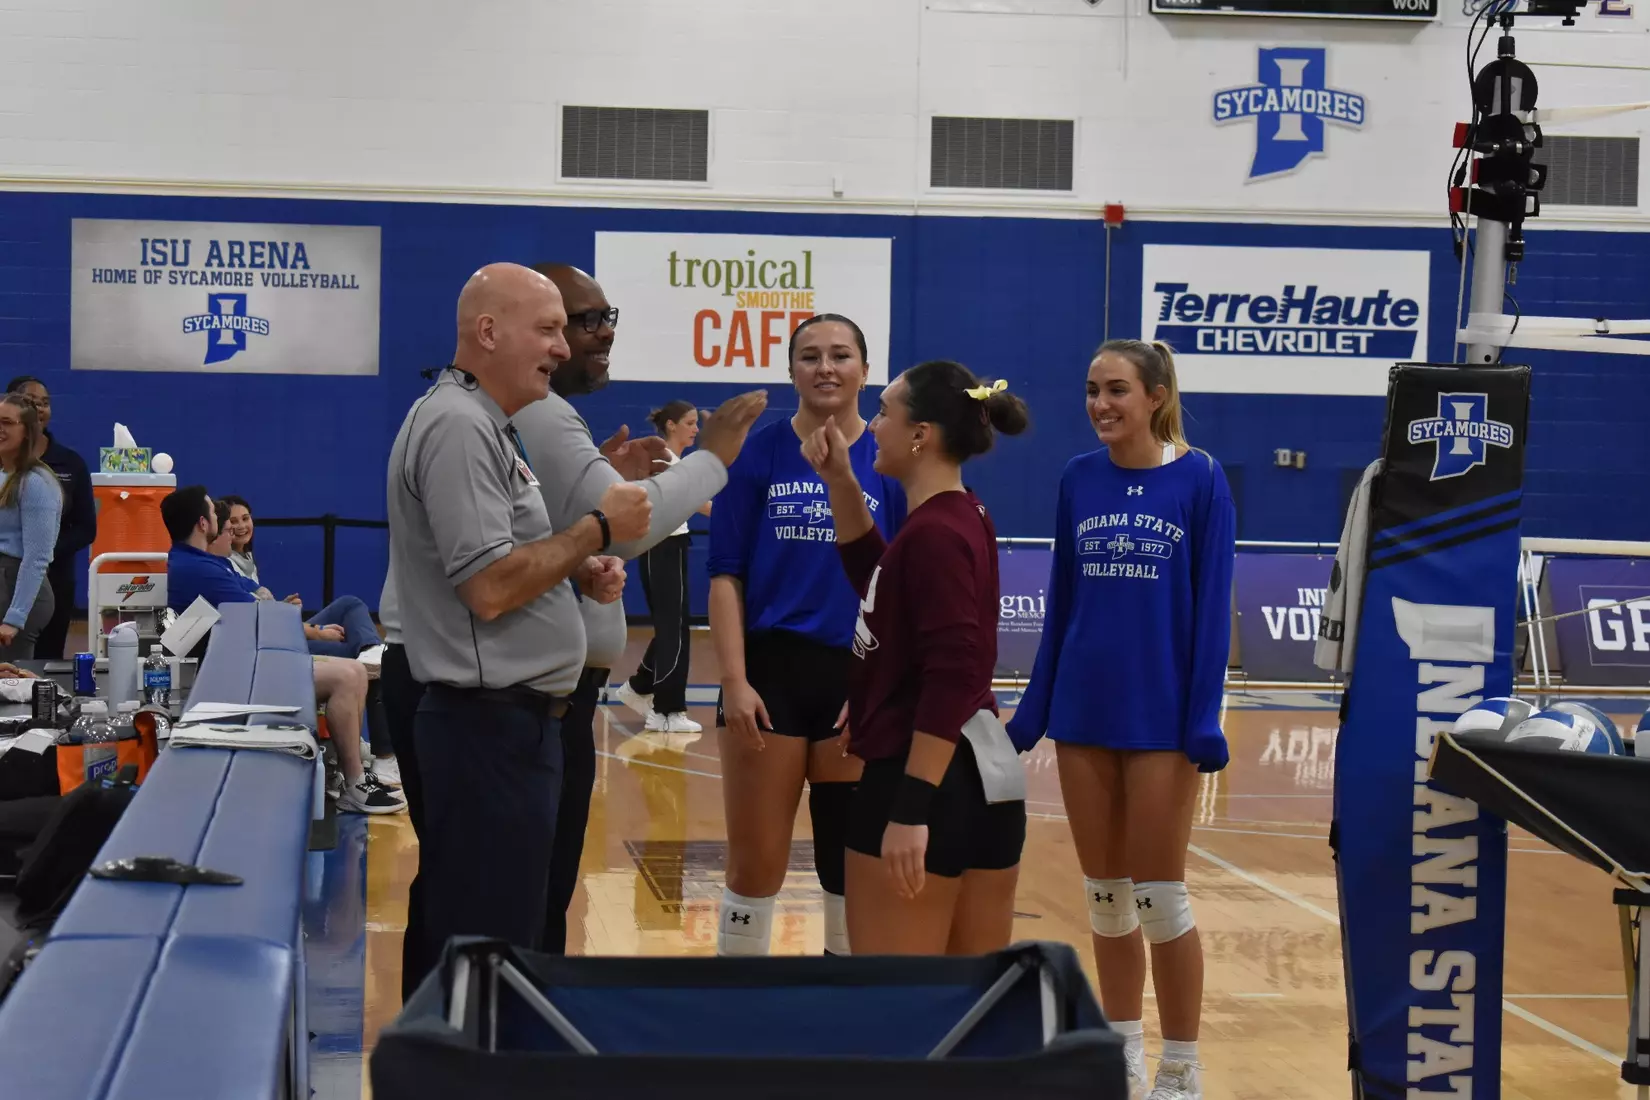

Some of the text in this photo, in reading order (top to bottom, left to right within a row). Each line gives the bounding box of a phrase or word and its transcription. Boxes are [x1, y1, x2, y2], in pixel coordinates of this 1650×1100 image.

[1216, 88, 1362, 123] SYCAMORES
[140, 238, 310, 270] ISU ARENA
[92, 268, 359, 290] HOME OF SYCAMORE VOLLEYBALL
[667, 249, 815, 296] tropical
[736, 291, 814, 309] SMOOTHIE
[184, 314, 269, 335] SYCAMORES
[1197, 328, 1374, 354] CHEVROLET
[1412, 420, 1510, 444] SYCAMORES
[775, 526, 838, 542] VOLLEYB
[1076, 513, 1185, 543] INDIANA STATE
[1141, 542, 1164, 554] 1977
[1083, 563, 1159, 580] VOLLEYBALL
